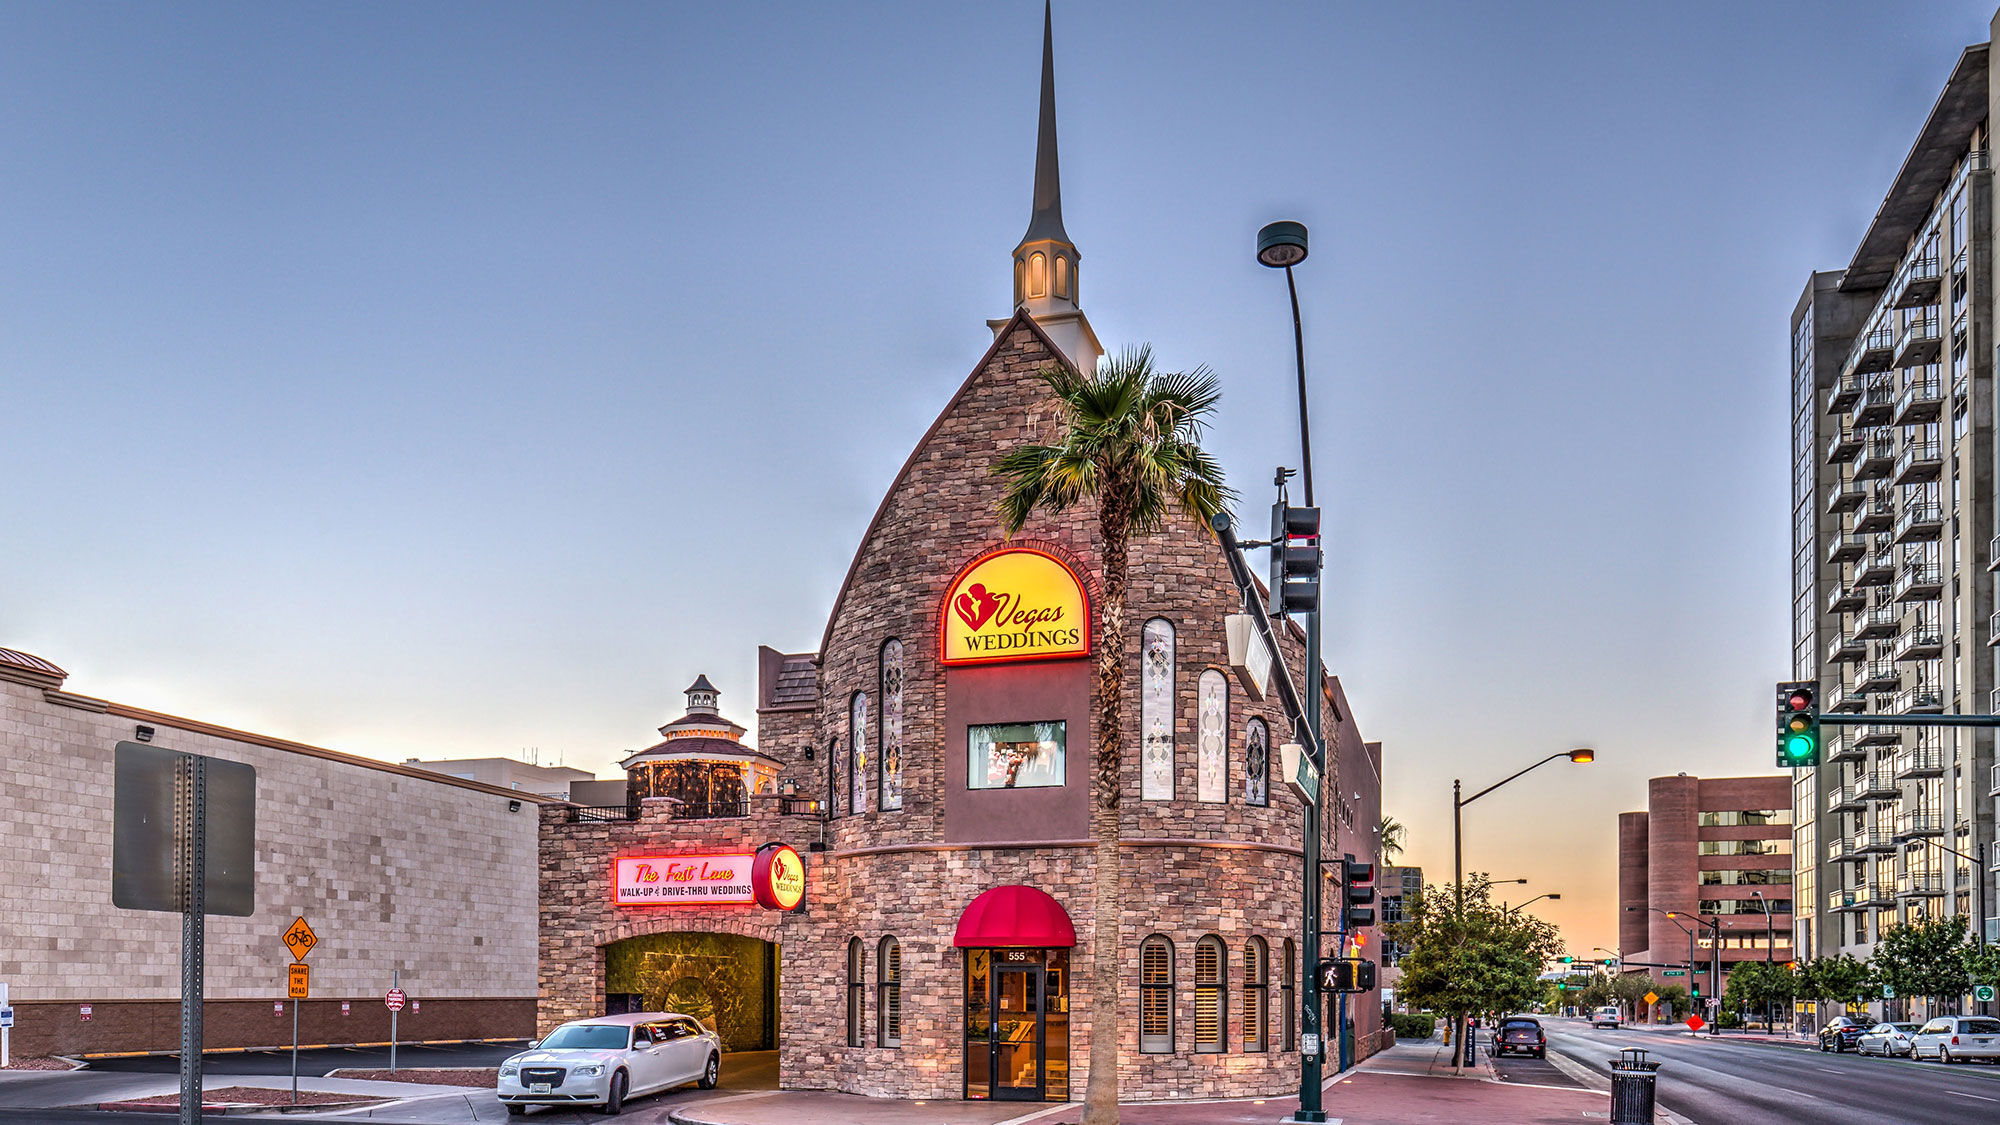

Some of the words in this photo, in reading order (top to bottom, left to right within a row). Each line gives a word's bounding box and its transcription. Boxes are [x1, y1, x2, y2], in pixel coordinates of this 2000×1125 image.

[994, 593, 1065, 633] Vegas
[964, 628, 1080, 651] WEDDINGS
[635, 864, 659, 883] The
[665, 862, 697, 882] Fast
[699, 861, 734, 881] Lane
[782, 864, 799, 884] Vegas
[620, 887, 654, 897] WALK-UP
[662, 886, 708, 896] DRIVE-THRU
[711, 885, 752, 895] WEDDINGS
[775, 882, 802, 894] WEDDINGS
[1008, 951, 1025, 961] 555
[291, 967, 307, 975] SHARE
[294, 977, 304, 985] THE
